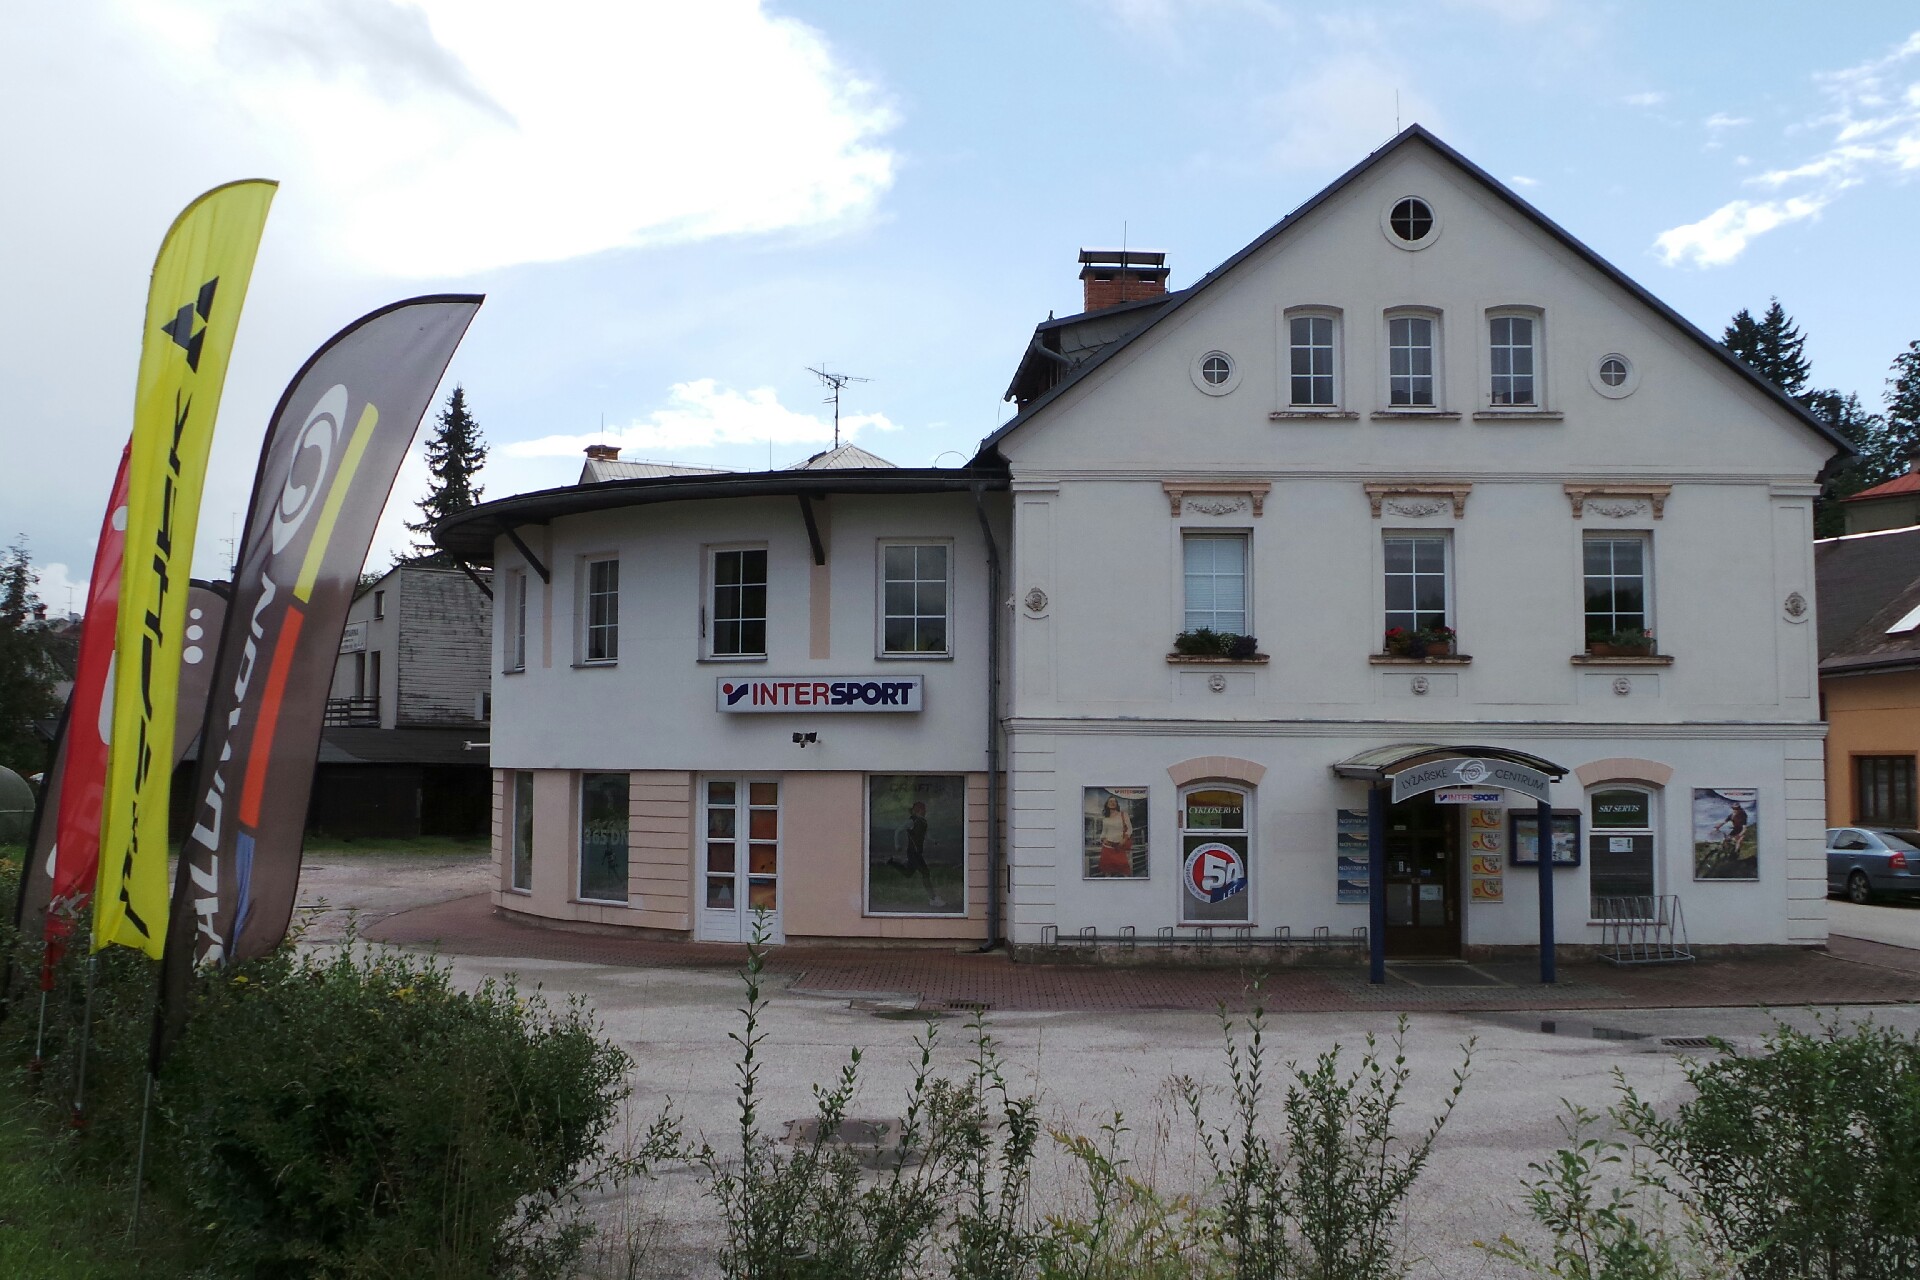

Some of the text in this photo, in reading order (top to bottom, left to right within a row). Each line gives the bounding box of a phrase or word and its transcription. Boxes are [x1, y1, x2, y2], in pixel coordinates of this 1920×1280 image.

[752, 682, 913, 706] INTERSPORT
[1401, 767, 1545, 791] LYŽAŘSKÉ CENTRUM
[1447, 793, 1499, 802] INTERSPORT
[1188, 806, 1241, 814] CYKLOSERVIS
[1598, 804, 1641, 813] SKI SERVIS
[584, 828, 608, 846] 365
[1201, 853, 1239, 891] 50
[1223, 885, 1238, 900] LET
